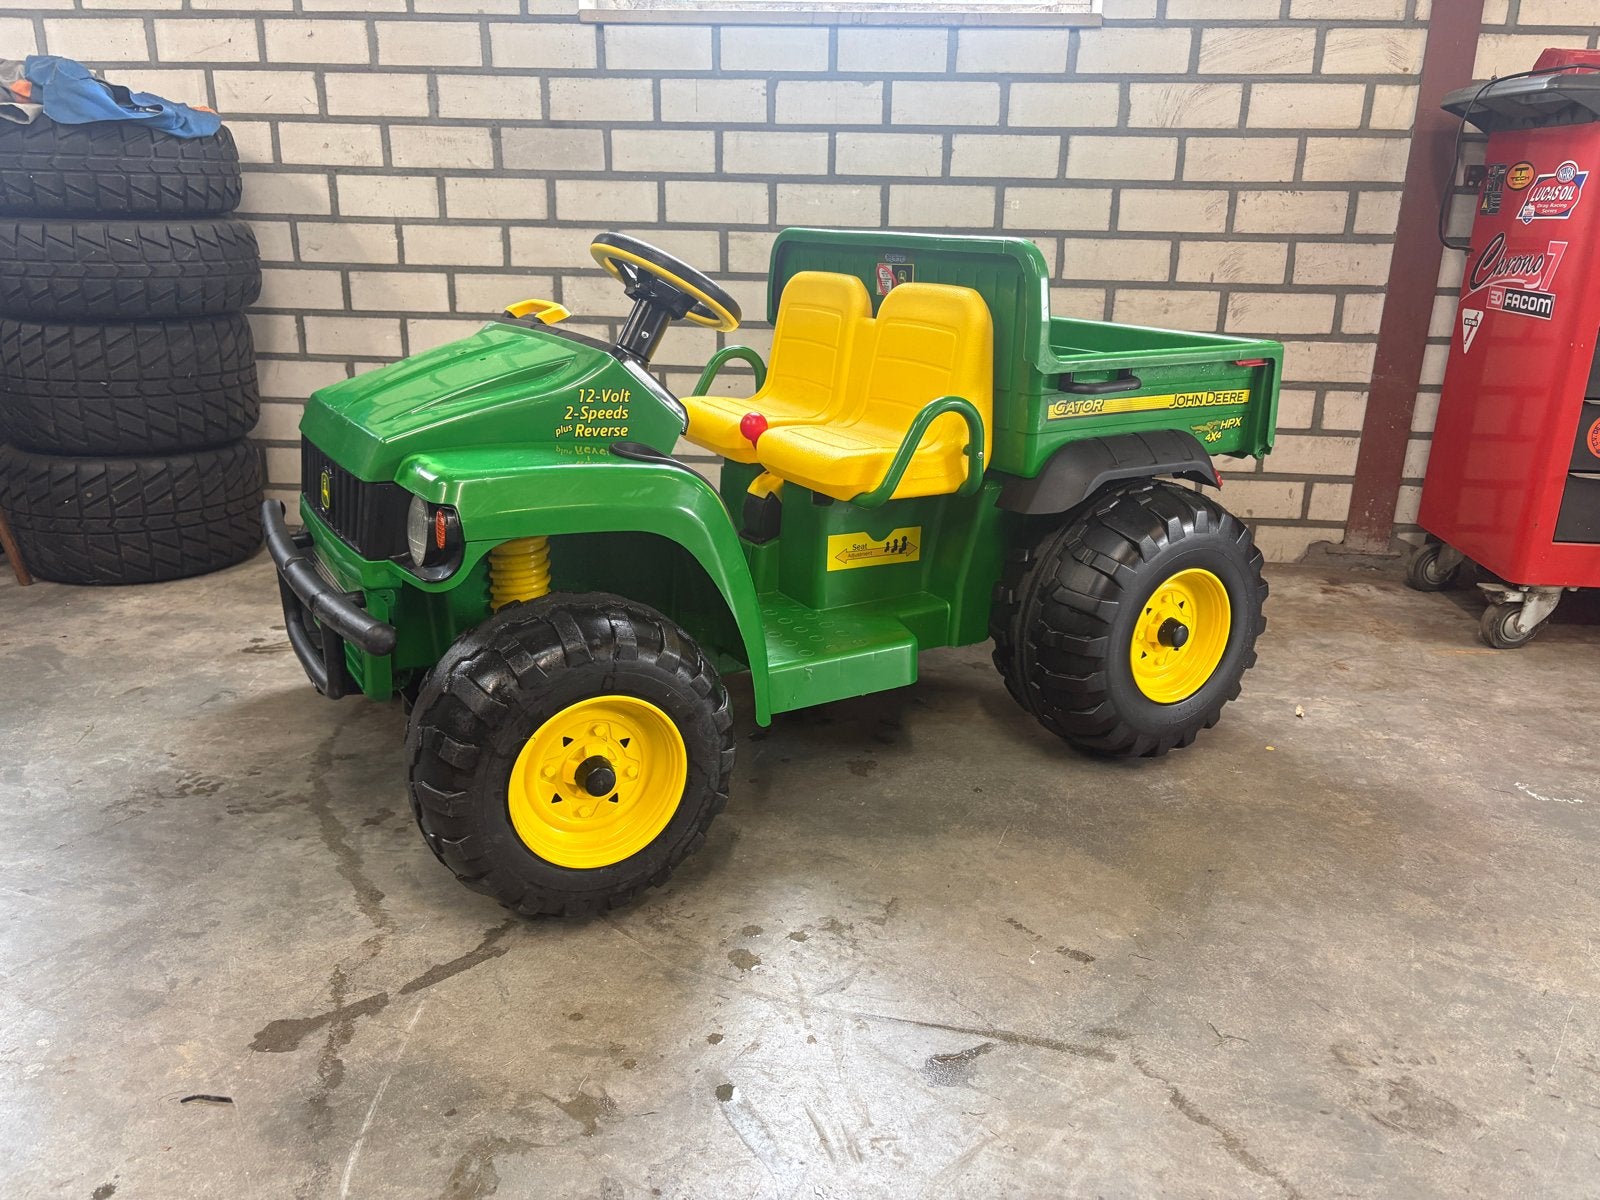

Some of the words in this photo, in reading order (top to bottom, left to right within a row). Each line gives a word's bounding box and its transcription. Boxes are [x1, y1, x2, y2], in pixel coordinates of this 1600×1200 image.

[1530, 186, 1561, 202] LUCAS
[1560, 185, 1576, 200] OIL
[1469, 232, 1544, 291] Chrono
[1504, 293, 1552, 314] FACOM
[579, 388, 631, 403] 12-Volt
[1053, 399, 1105, 415] GATOR
[1169, 393, 1204, 407] JOHN
[1206, 391, 1244, 404] DEERE
[564, 405, 629, 423] 2-Speeds
[555, 424, 573, 437] plus
[575, 423, 629, 437] Reverse
[1220, 417, 1243, 430] HPX
[852, 543, 868, 551] Seat
